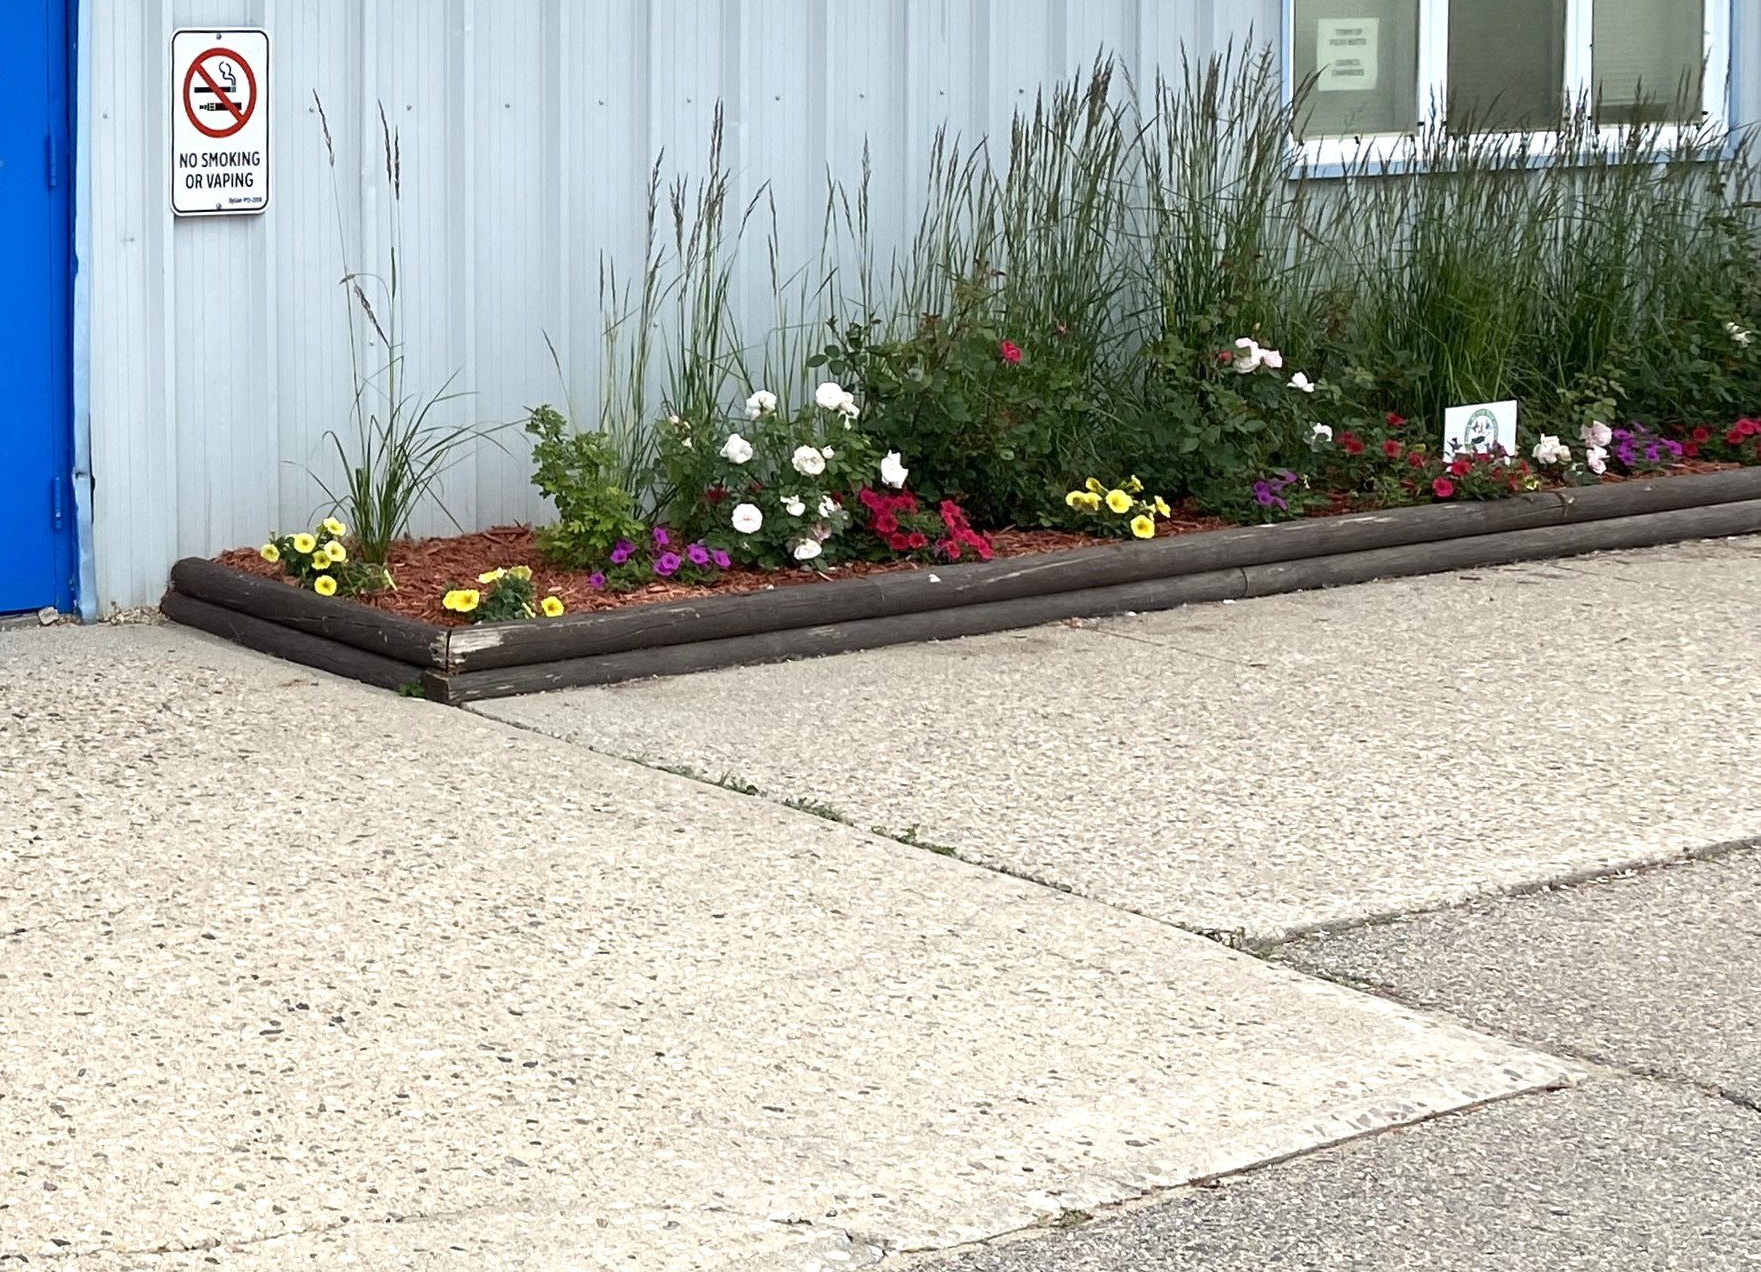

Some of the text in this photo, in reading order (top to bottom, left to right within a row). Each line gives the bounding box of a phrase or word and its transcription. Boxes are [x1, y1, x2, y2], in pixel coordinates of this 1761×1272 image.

[179, 150, 261, 169] NO SMOKING
[185, 172, 254, 190] OR VAPING
